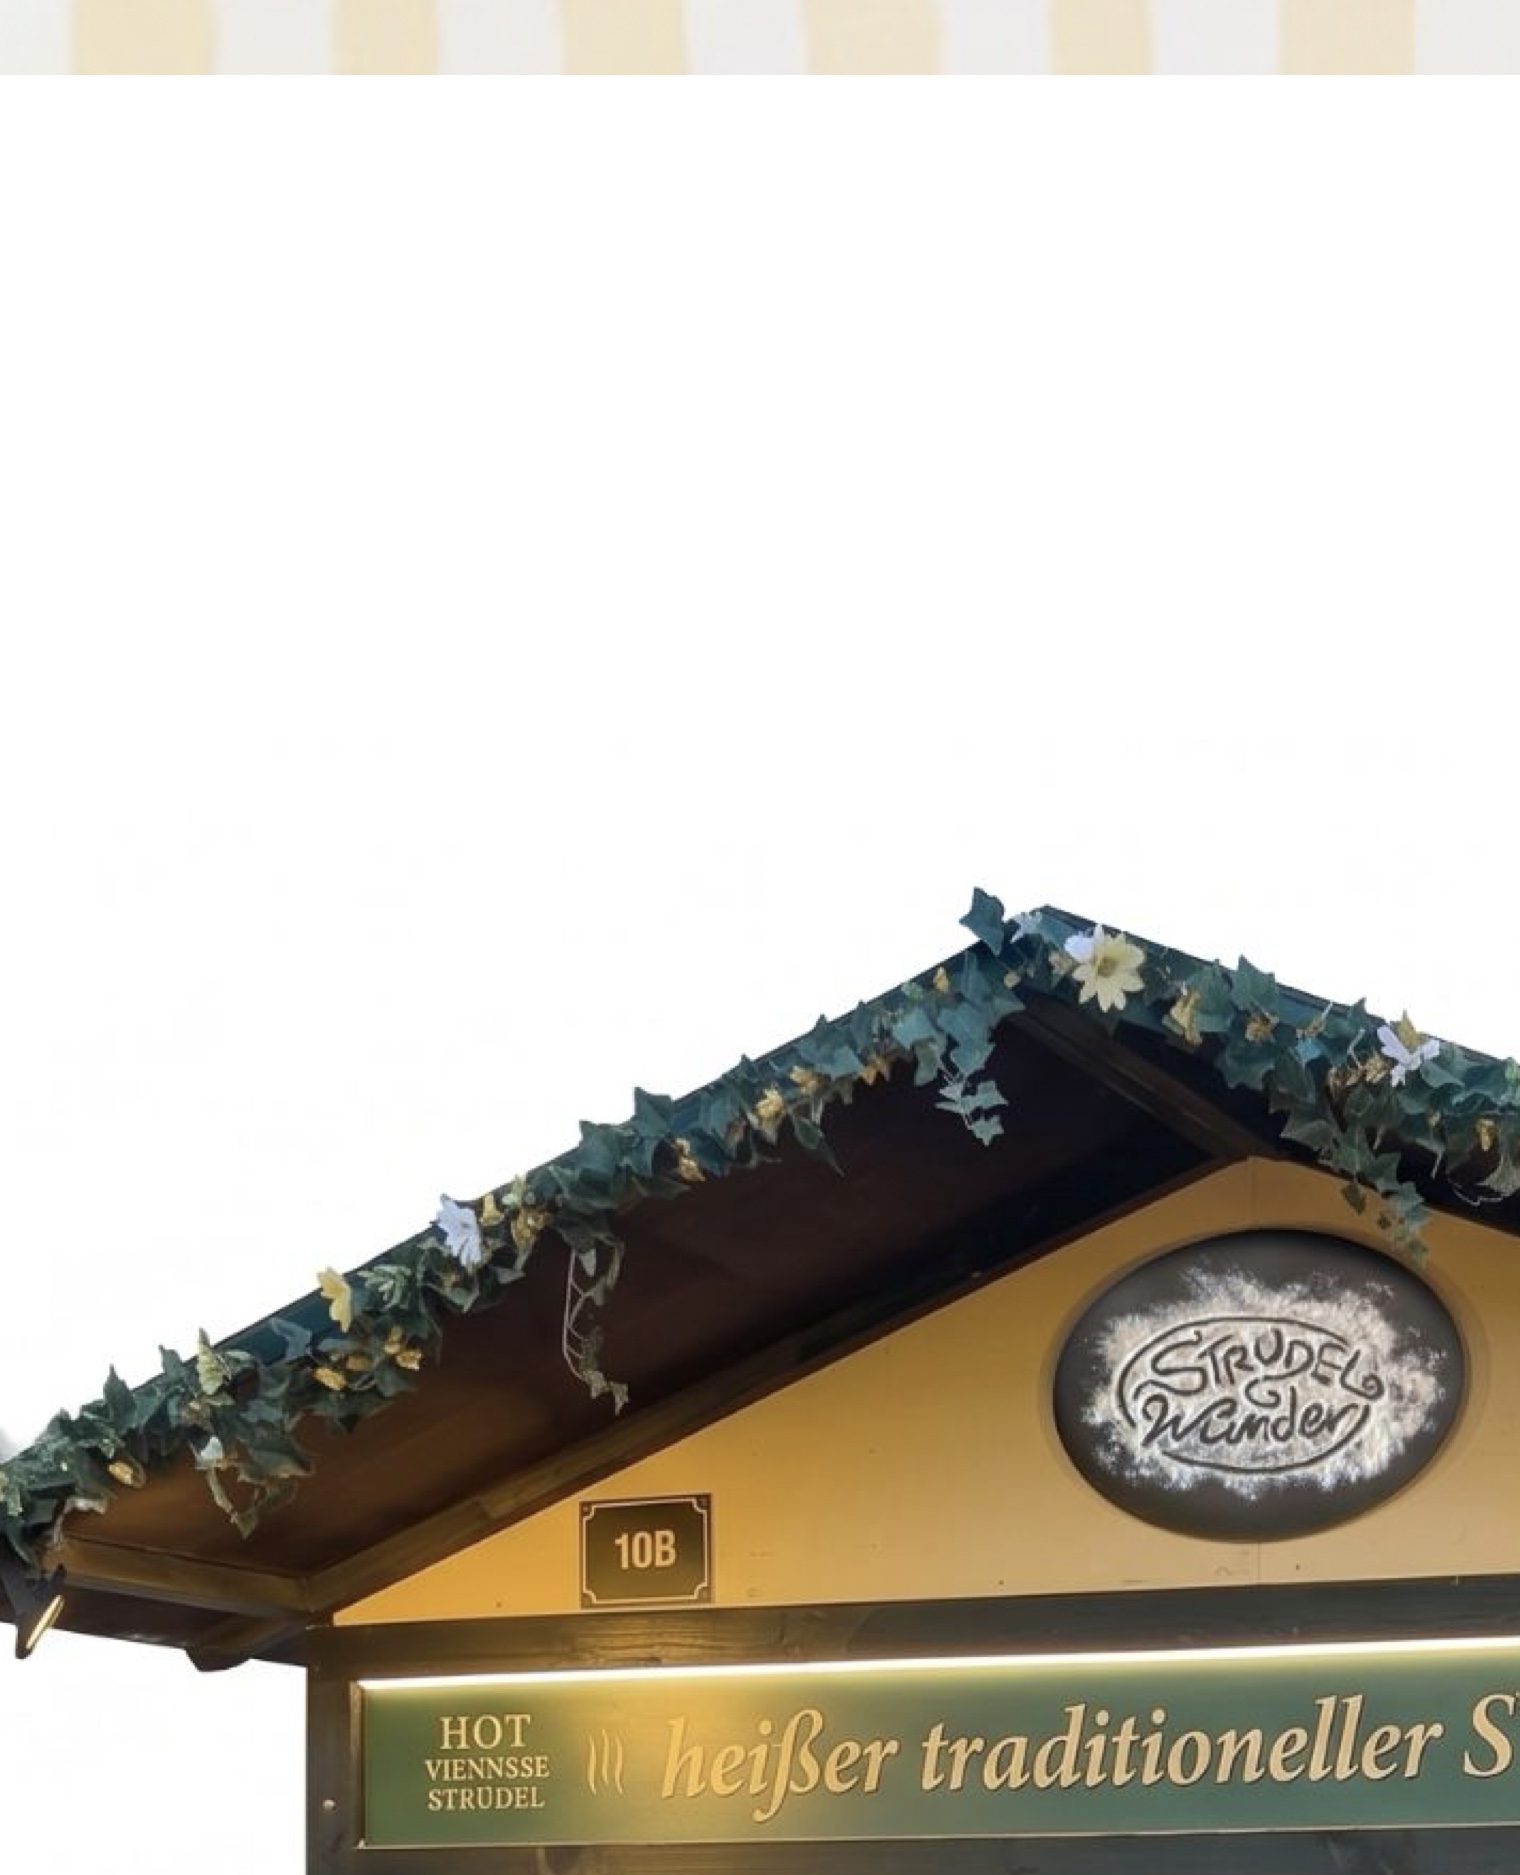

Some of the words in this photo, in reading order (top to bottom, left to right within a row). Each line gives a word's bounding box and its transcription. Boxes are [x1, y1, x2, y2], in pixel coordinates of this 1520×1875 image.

[1134, 1328, 1385, 1402] STRUDEL
[615, 1530, 676, 1570] 10B
[440, 1714, 531, 1750] HOT
[425, 1755, 550, 1782] VIENNSSE
[661, 1709, 900, 1822] heißer
[921, 1695, 1444, 1792] traditioneller
[428, 1785, 546, 1812] STRUDEL
